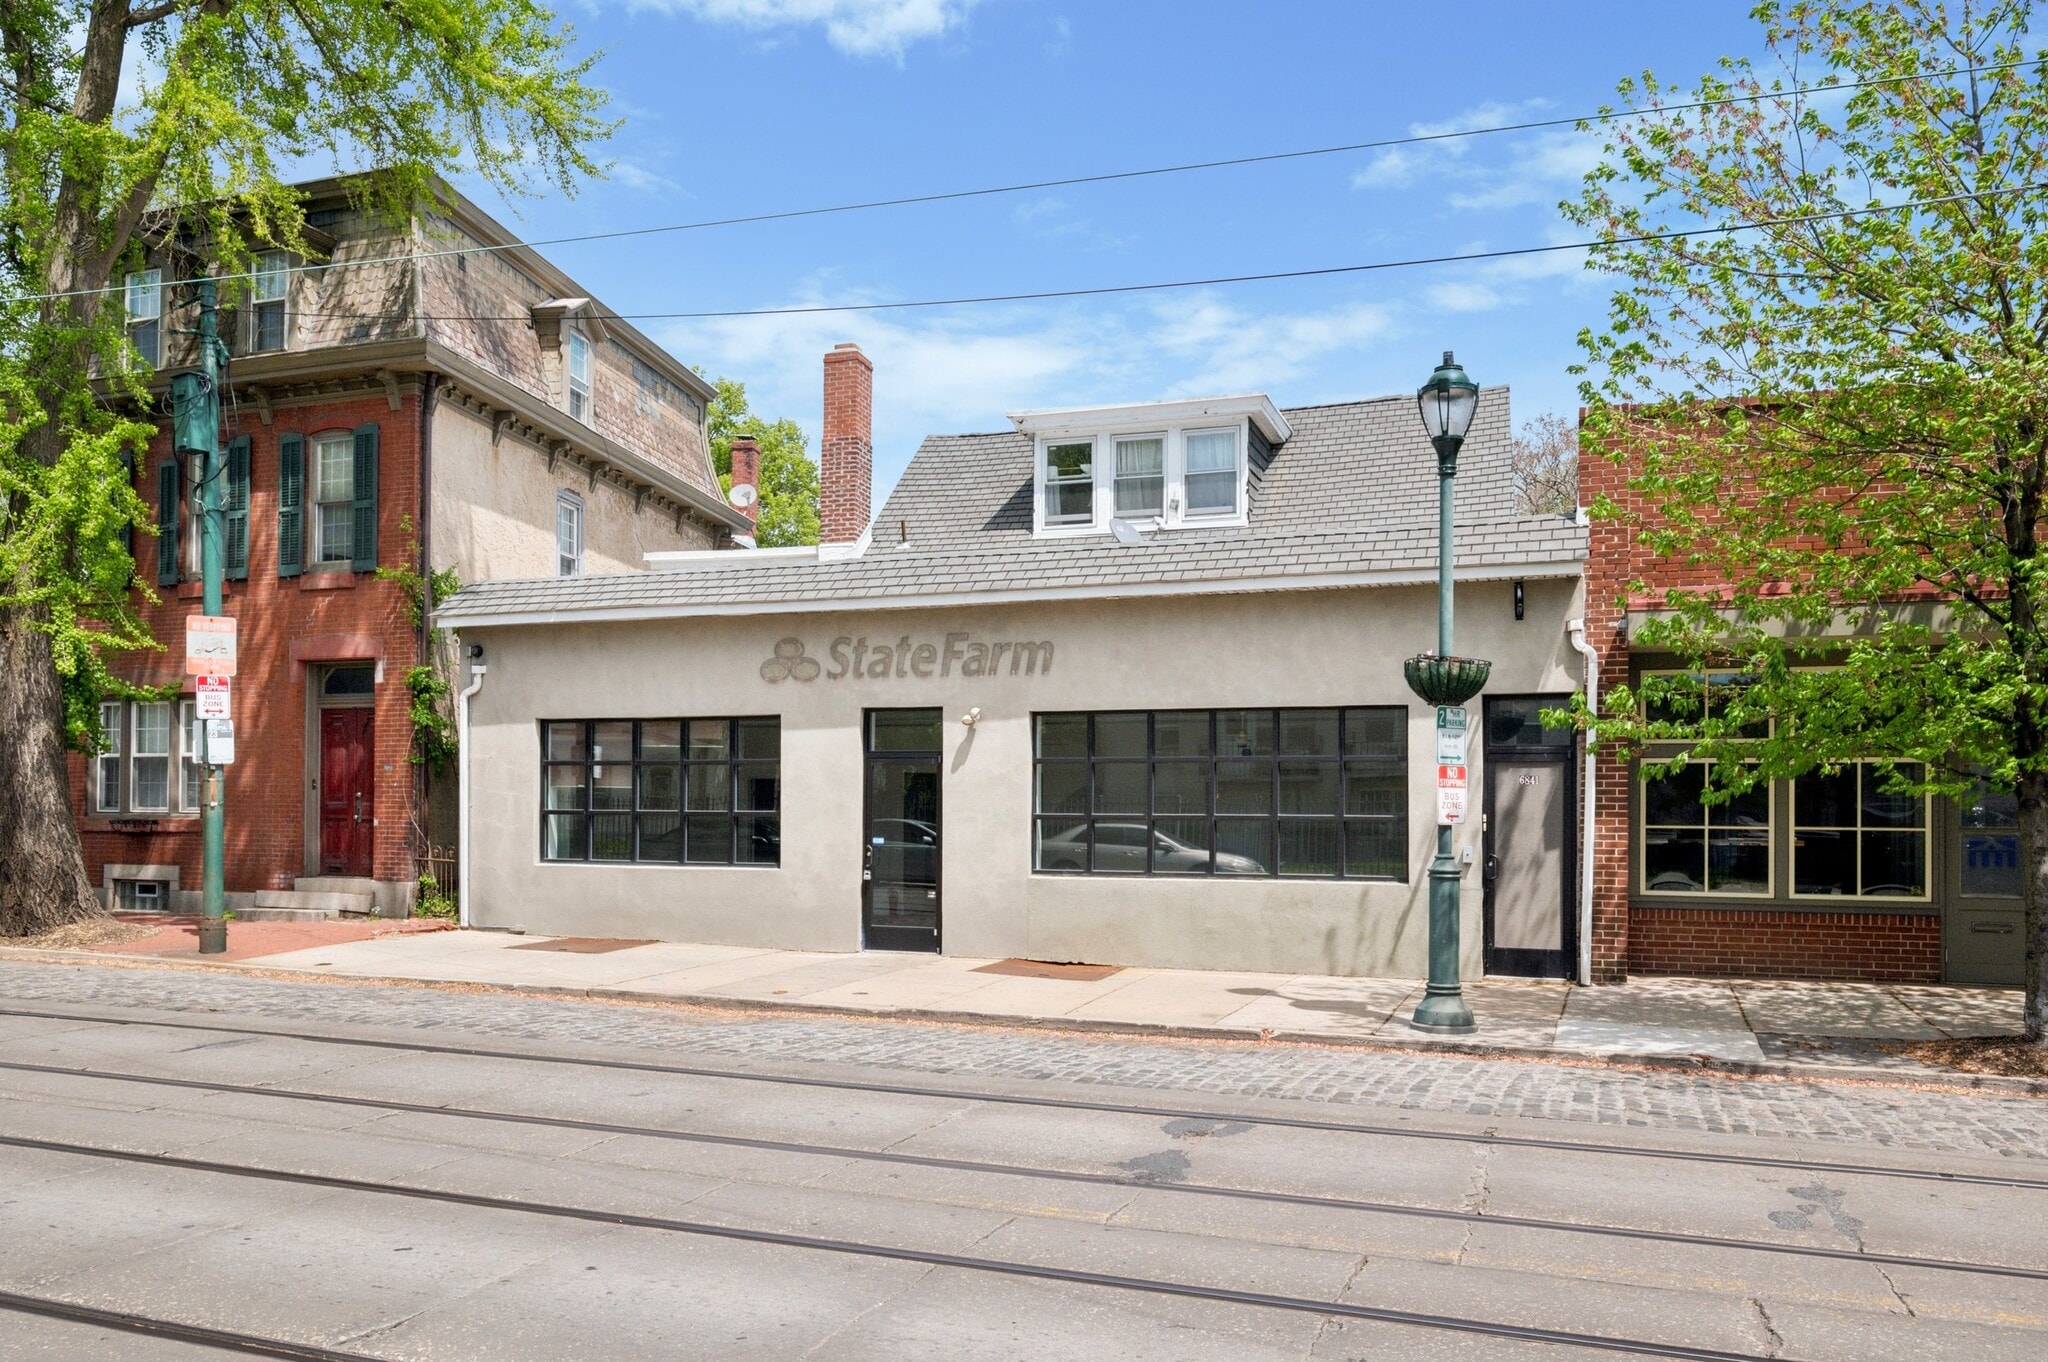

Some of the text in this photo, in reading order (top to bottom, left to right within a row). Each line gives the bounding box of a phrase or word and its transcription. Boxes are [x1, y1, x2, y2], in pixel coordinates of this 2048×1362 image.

[207, 676, 219, 686] NO
[1439, 710, 1446, 726] 2
[1446, 719, 1466, 727] PARKING
[209, 730, 218, 738] 23
[1447, 766, 1458, 779] NO
[1439, 778, 1466, 787] STOPPING
[1519, 775, 1539, 785] 6841
[1444, 792, 1460, 801] BUS
[1441, 801, 1463, 810] ZONE
